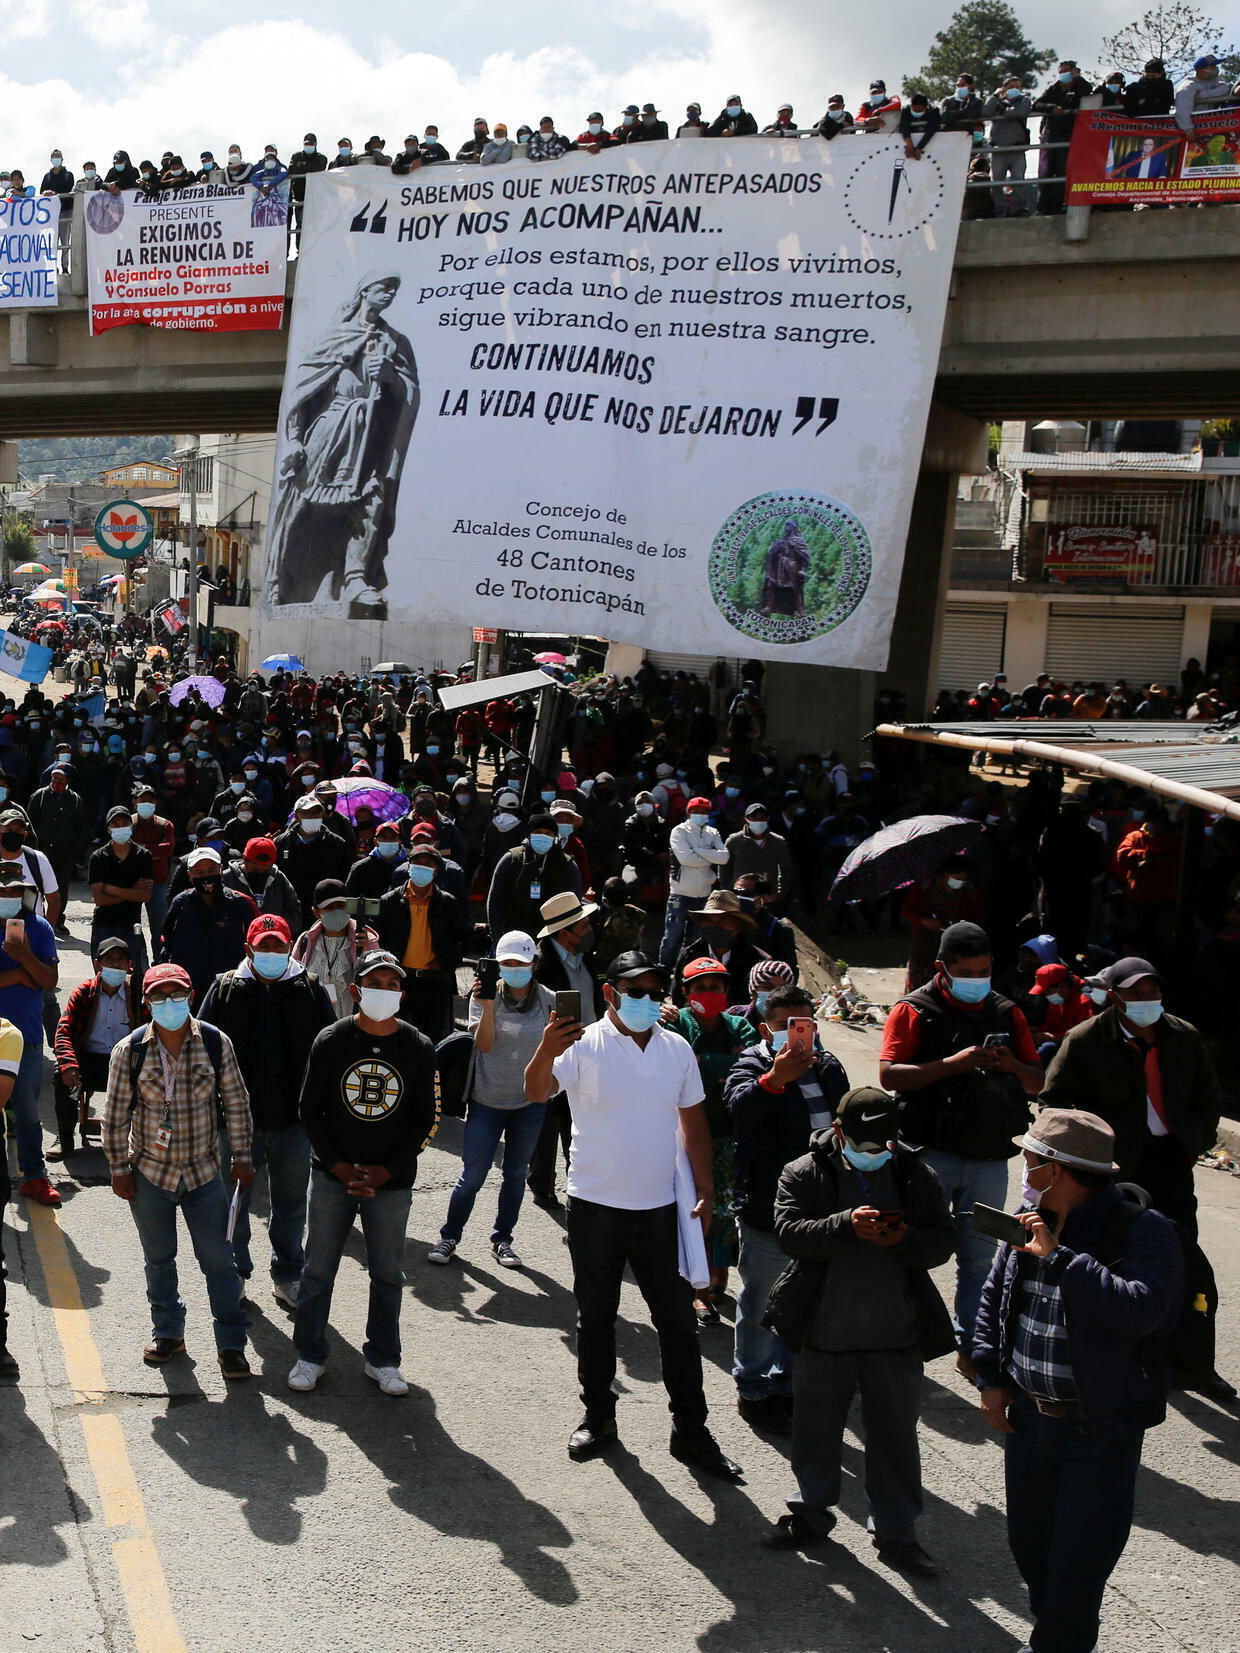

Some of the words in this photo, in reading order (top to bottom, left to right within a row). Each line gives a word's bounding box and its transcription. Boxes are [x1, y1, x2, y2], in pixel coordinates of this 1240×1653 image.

[172, 186, 205, 200] Tierra
[401, 181, 494, 206] SABEMOS
[503, 178, 542, 200] QUE
[550, 174, 656, 195] NUESTROS
[663, 173, 823, 194] ANTEPASADOS
[1071, 182, 1125, 193] AVANCEMOS
[1126, 181, 1154, 191] HACIA
[1156, 181, 1165, 190] EL
[1166, 179, 1201, 190] ESTADO
[149, 205, 215, 222] PRESENTE
[398, 213, 450, 242] HOY
[456, 210, 510, 236] NOS
[520, 200, 723, 234] ACOMPAÑAN...
[139, 221, 223, 244] EXIGIMOS
[116, 249, 134, 266] LA
[139, 243, 226, 265] RENUNCIA
[233, 241, 254, 260] DE
[439, 254, 479, 272] Por
[485, 247, 542, 267] ellos
[550, 250, 655, 273] estamos,
[660, 255, 709, 276] por
[716, 252, 779, 272] ellos
[788, 252, 902, 278] vivimos,
[104, 266, 172, 284] Alejandro
[176, 261, 270, 279] Giammattei
[116, 282, 179, 298] Consuelo
[183, 281, 232, 295] Porras
[417, 280, 505, 304] porque
[513, 277, 573, 296] cada
[582, 282, 628, 300] uno
[635, 285, 662, 305] de
[669, 287, 782, 307] nuestros
[790, 289, 913, 313] muertos,
[110, 307, 120, 319] la
[142, 302, 246, 320] corrupción
[250, 304, 257, 313] a
[439, 308, 506, 331] sigue
[514, 308, 628, 333] vibrando
[635, 322, 662, 338] en
[668, 321, 766, 340] nuestra
[774, 324, 876, 349] sangre.
[470, 343, 655, 385] CONTINUAMOS
[439, 389, 468, 417] LA
[479, 389, 535, 420] VIDA
[544, 391, 598, 426] QUE
[604, 397, 652, 434] NOS
[659, 405, 782, 438] DEJARON
[97, 523, 152, 533] Holandesa
[526, 501, 601, 522] Concejo
[606, 508, 627, 524] de
[452, 519, 530, 538] Alcaldes
[536, 525, 633, 550] Comunales
[636, 541, 658, 557] de
[662, 543, 687, 559] los
[497, 549, 523, 568] 48
[531, 551, 635, 582] Cantones
[476, 578, 505, 597] de
[511, 580, 645, 616] Totonicapán
[357, 1072, 387, 1107] B
